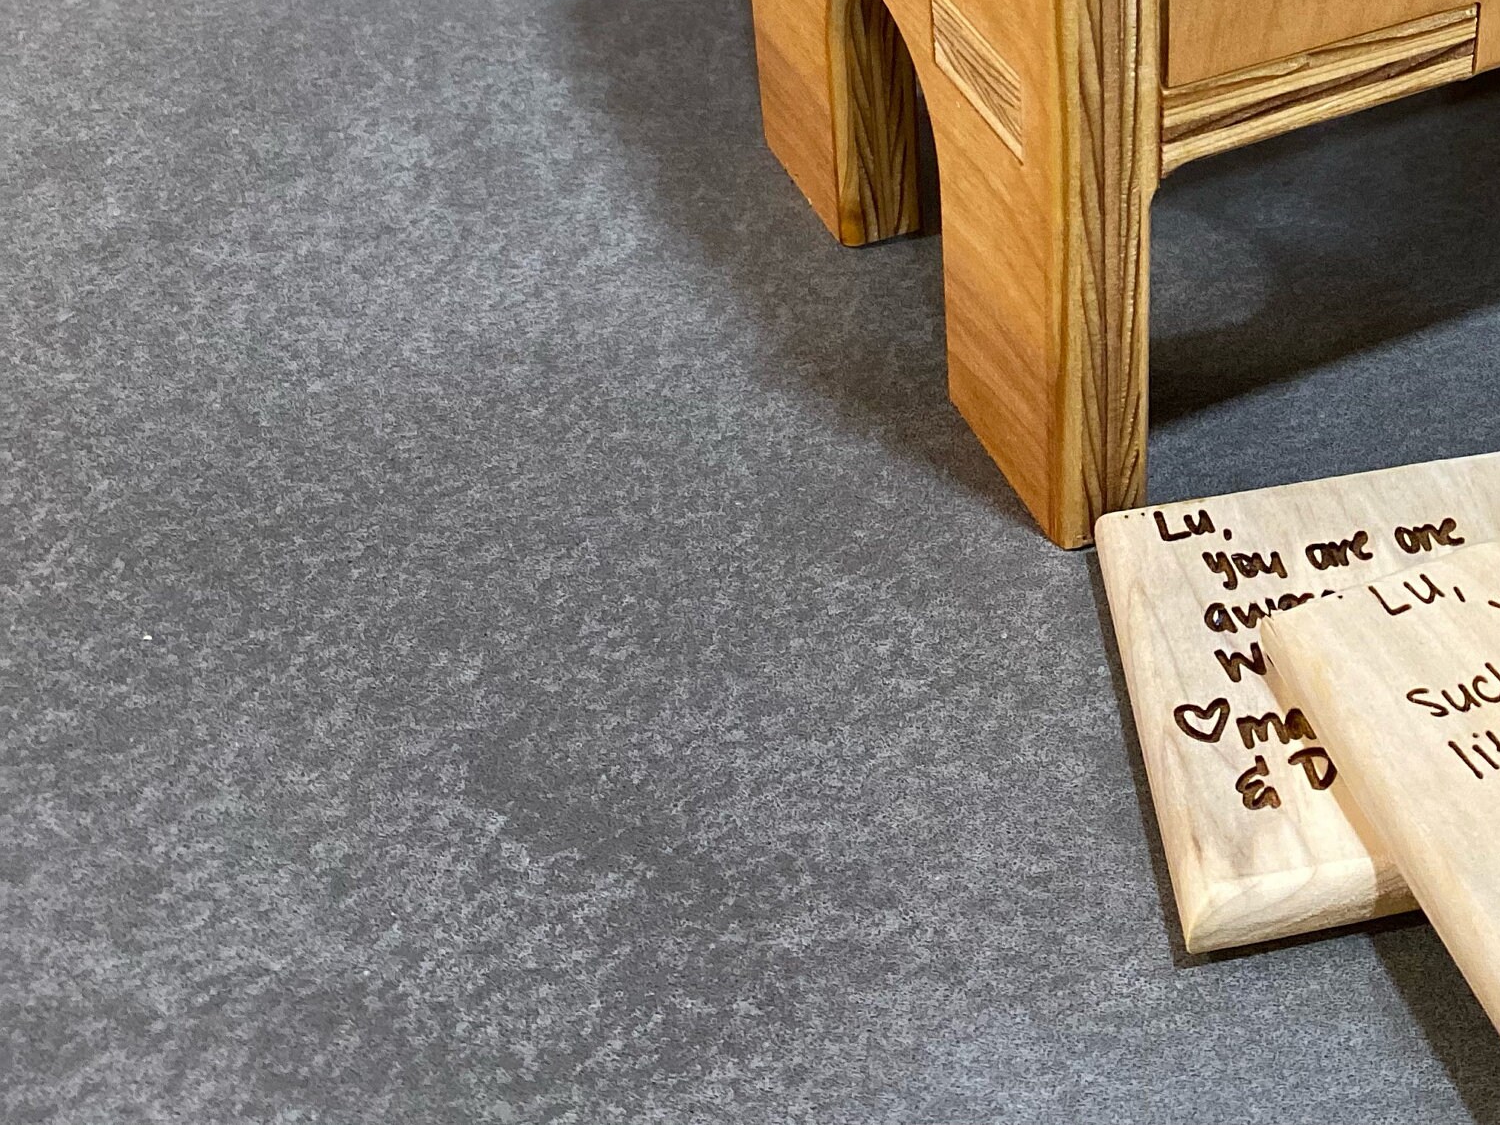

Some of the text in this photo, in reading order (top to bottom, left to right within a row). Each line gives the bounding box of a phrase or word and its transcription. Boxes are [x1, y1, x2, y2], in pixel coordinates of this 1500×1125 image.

[1153, 509, 1233, 542] Lu,
[1202, 518, 1465, 590] you are one
[1368, 573, 1466, 616] Lu,
